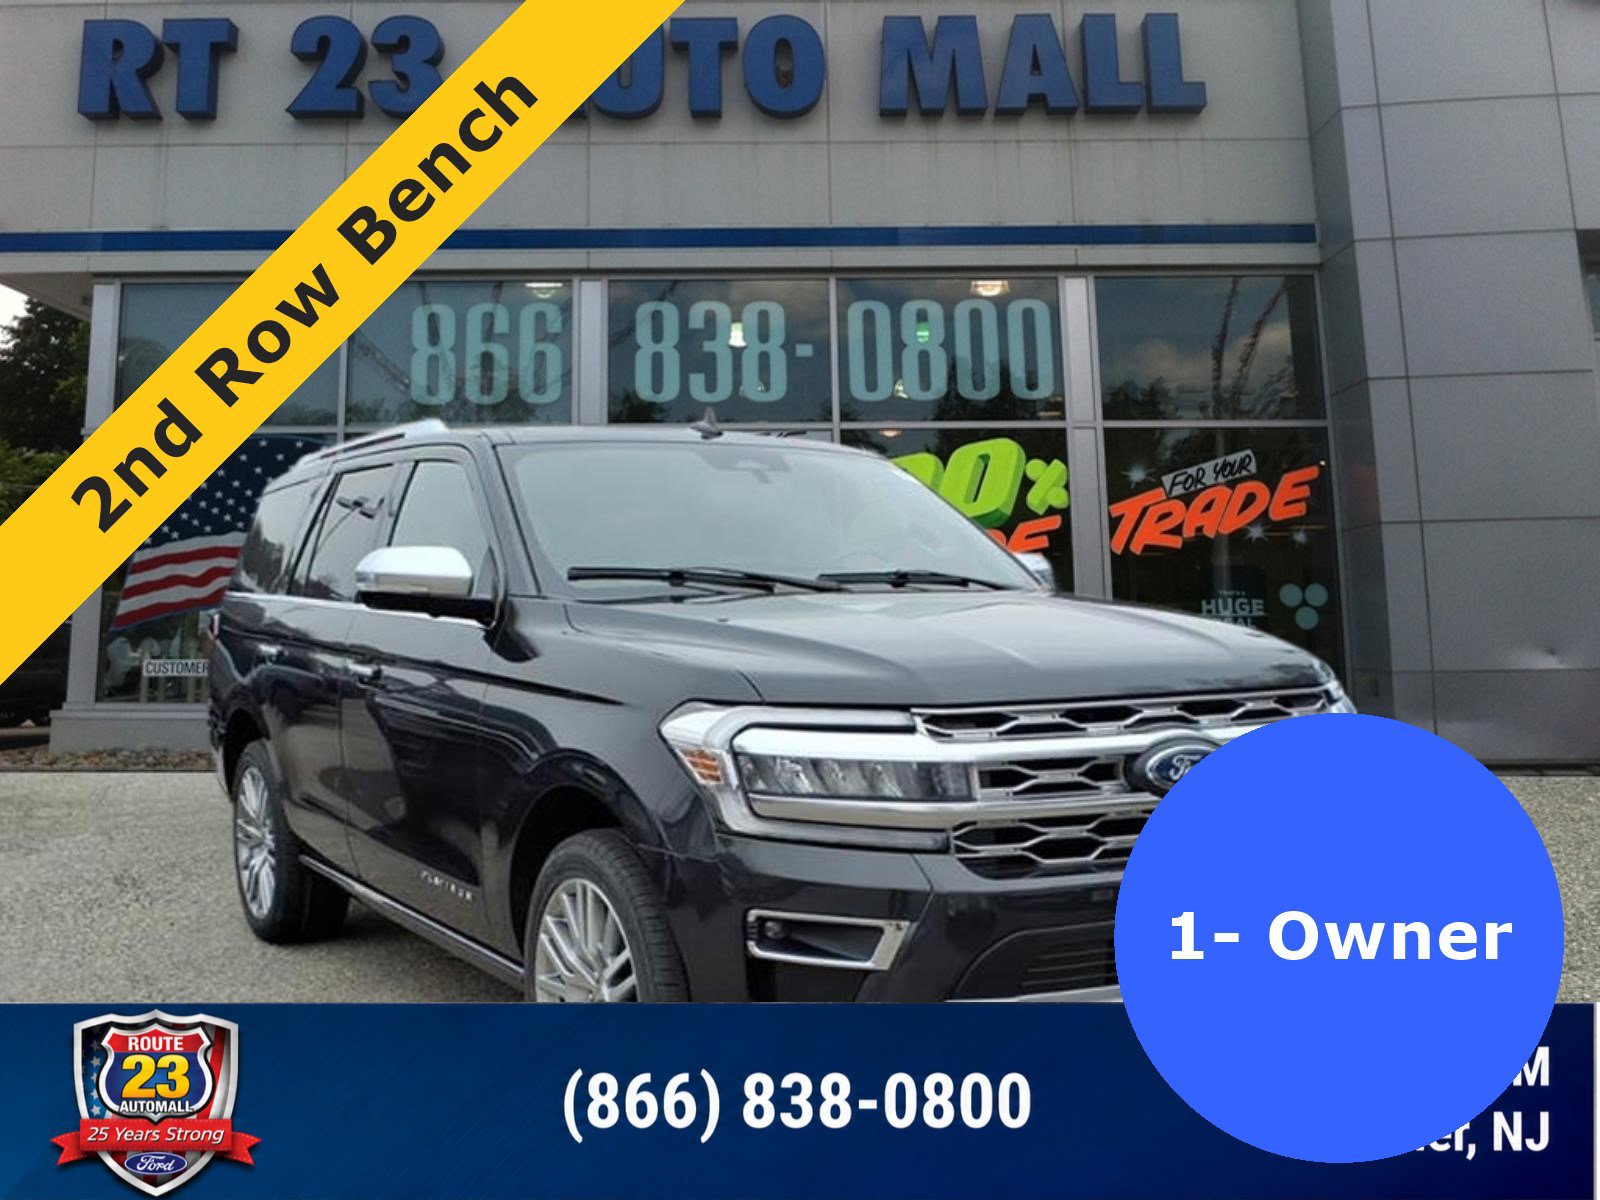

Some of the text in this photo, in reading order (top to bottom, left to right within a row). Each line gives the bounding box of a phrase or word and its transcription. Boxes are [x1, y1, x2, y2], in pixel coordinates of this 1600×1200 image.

[78, 13, 1207, 119] RT 23 UTO MALL
[410, 301, 564, 406] 866
[847, 298, 1055, 401] 0800
[1109, 465, 1320, 556] TRADE
[1168, 454, 1252, 495] FOR YOUR
[1201, 597, 1265, 616] HUGE
